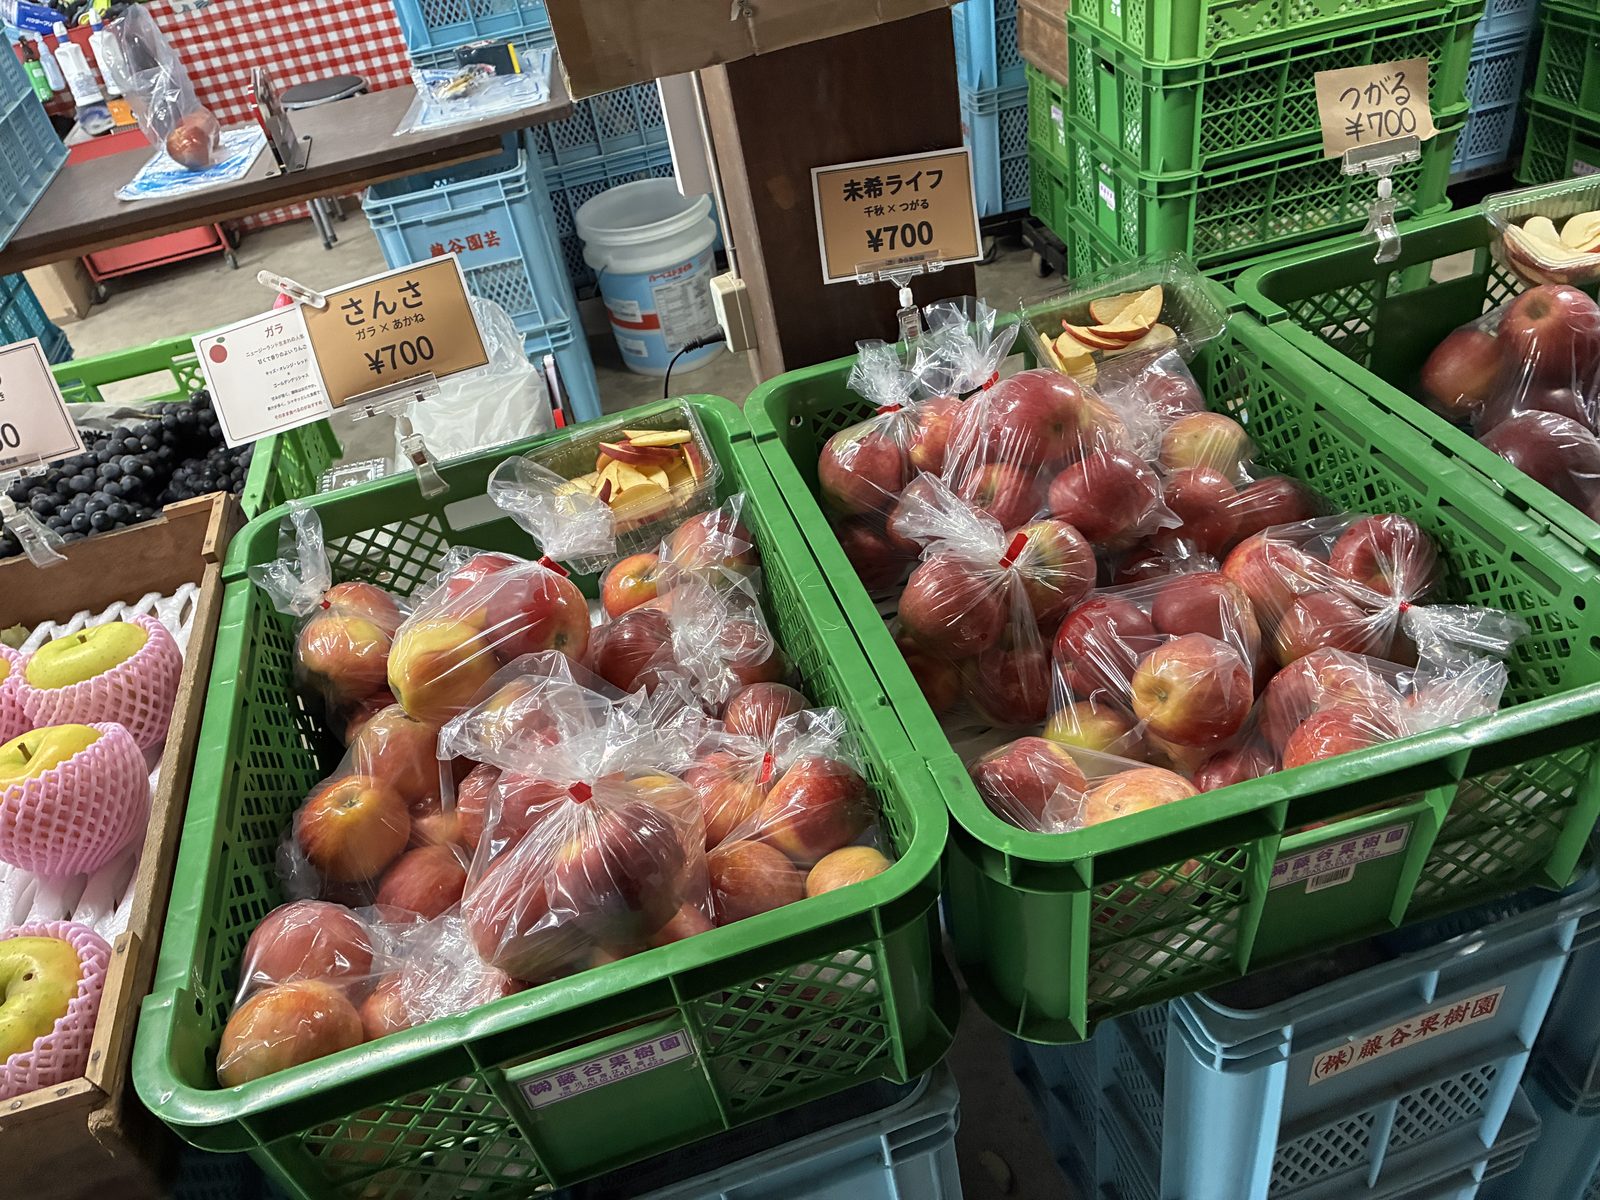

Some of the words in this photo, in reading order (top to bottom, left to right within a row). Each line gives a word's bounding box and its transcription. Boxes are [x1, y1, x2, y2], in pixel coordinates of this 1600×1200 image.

[1340, 71, 1411, 110] つがる
[1345, 107, 1416, 142] ¥700
[843, 169, 943, 202] 未希ライフ
[866, 220, 934, 252] ¥700
[341, 280, 423, 326] さんさ
[264, 323, 284, 338] ガラ
[364, 335, 434, 374] ¥700
[1314, 993, 1500, 1078] (株)藤谷果樹園
